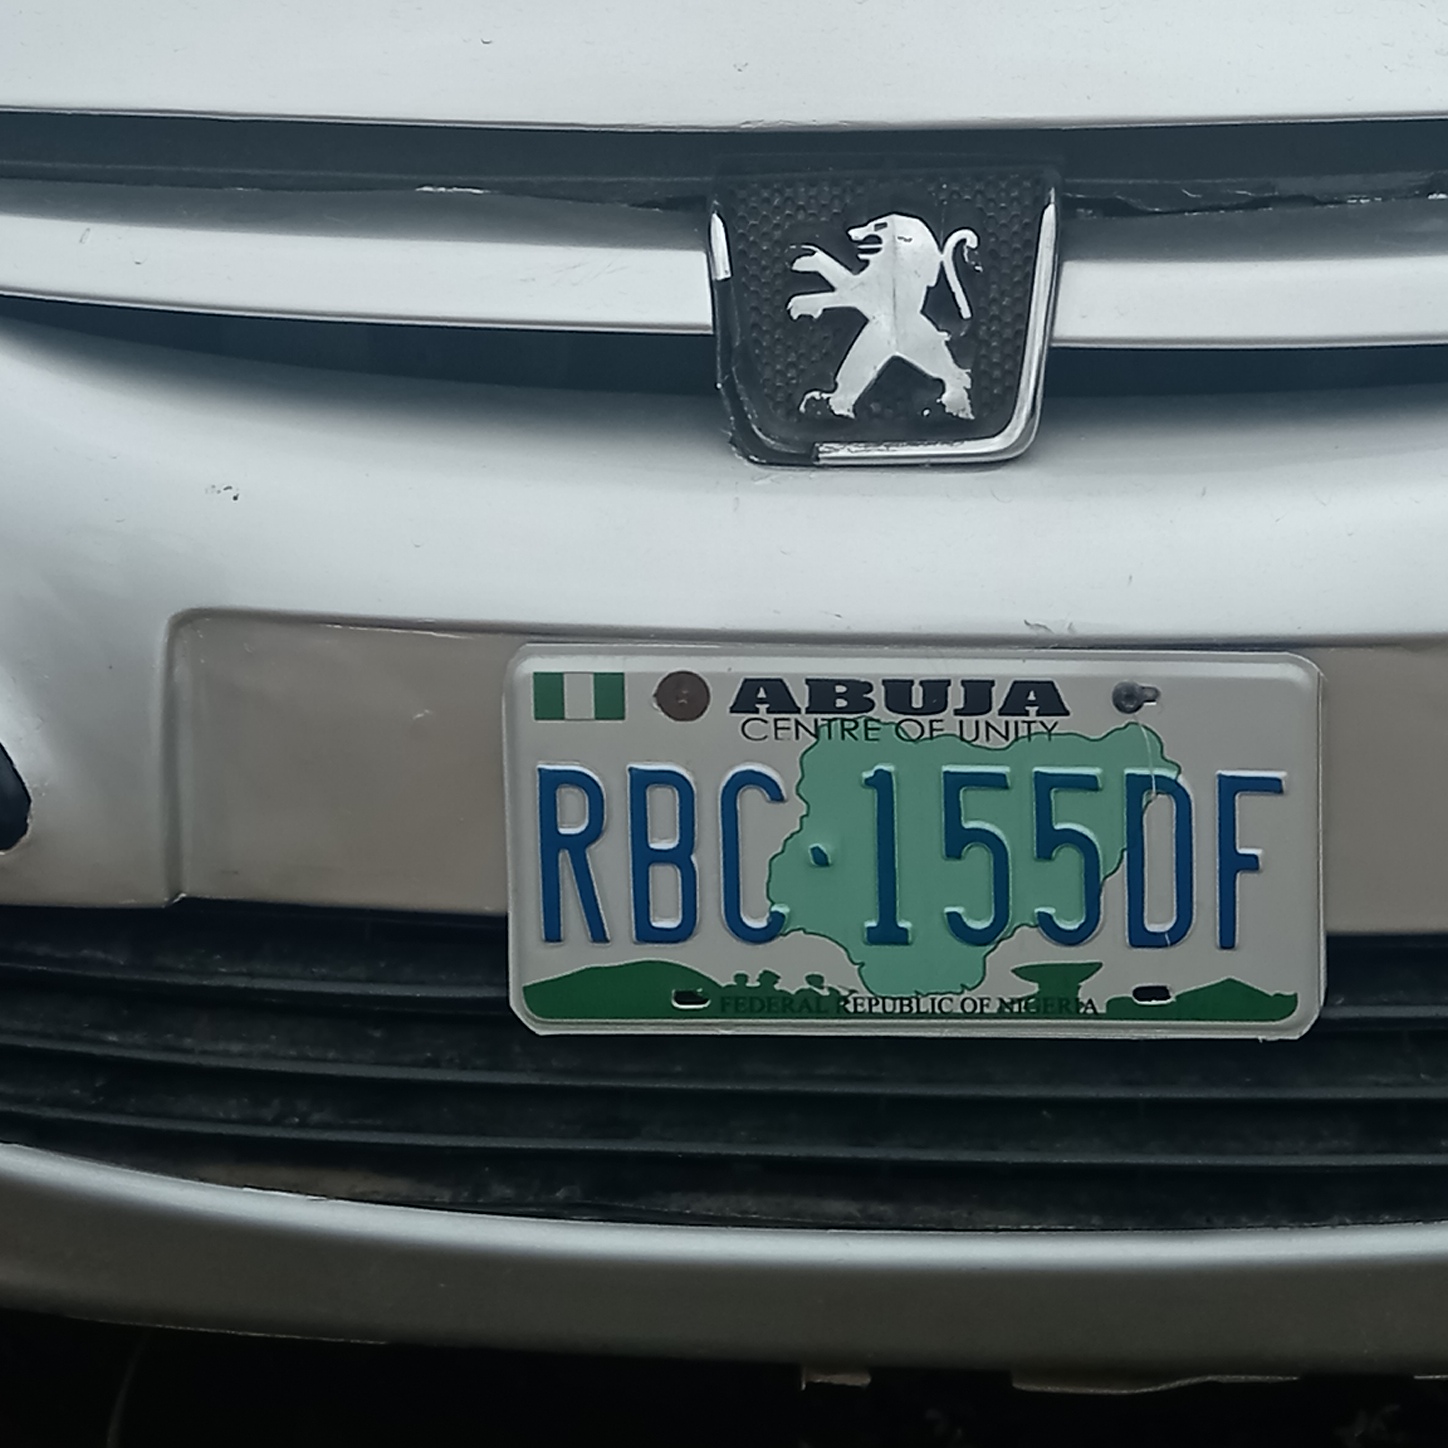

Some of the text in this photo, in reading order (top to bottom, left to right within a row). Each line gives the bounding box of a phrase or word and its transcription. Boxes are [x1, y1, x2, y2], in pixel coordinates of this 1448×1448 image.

[729, 677, 1071, 717] ABUJA
[740, 717, 1059, 743] CENTRE OF UNITY
[719, 995, 1100, 1017] FEDERAL REPUBLIC OF NIGERIA
